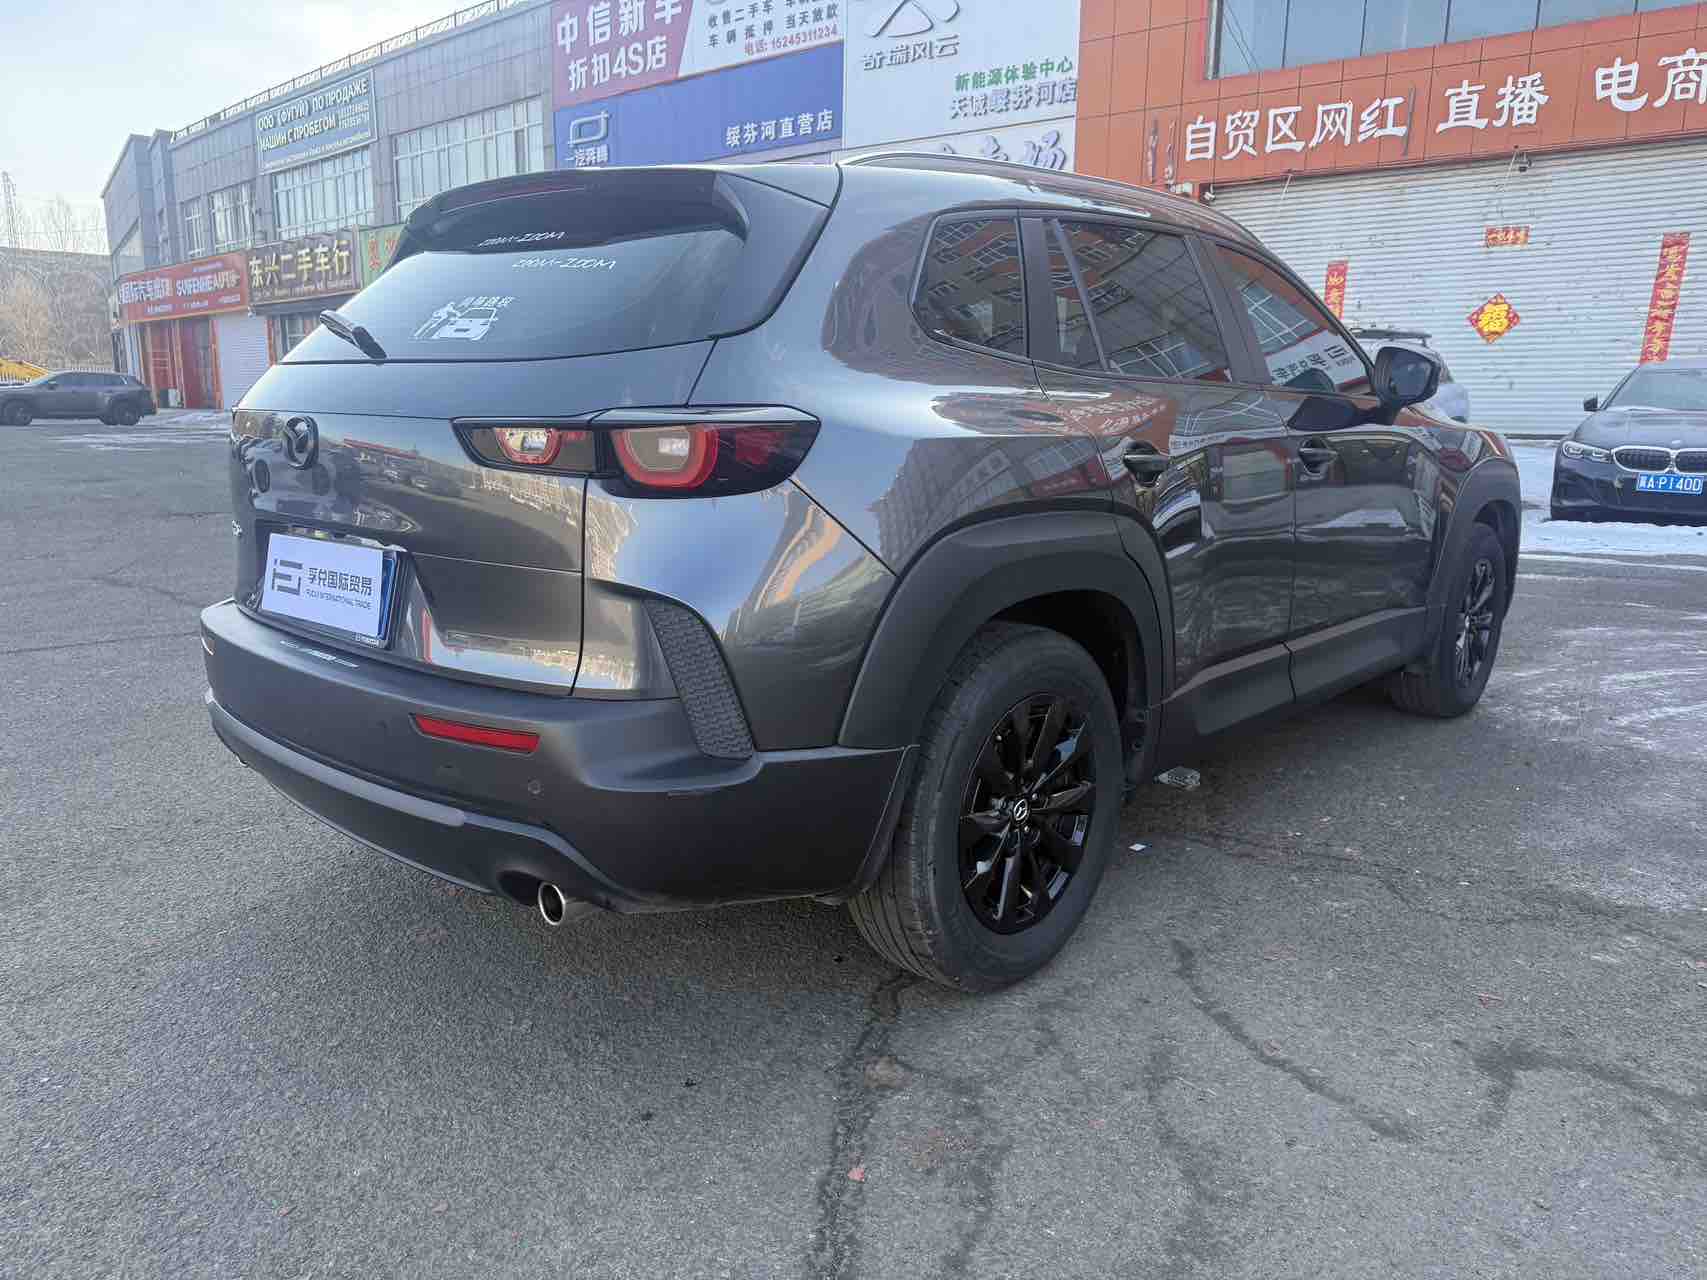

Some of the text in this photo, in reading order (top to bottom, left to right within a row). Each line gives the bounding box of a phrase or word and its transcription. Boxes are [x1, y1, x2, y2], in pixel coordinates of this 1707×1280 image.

[556, 0, 682, 54] 中信新车
[568, 36, 667, 92] 折扣4S店
[954, 56, 1073, 92] 新能源体验中心
[726, 108, 833, 148] 绥芬河直营店
[1185, 47, 1707, 162] 自贸区网红 直播 电商
[249, 239, 350, 288] 东兴二手车行
